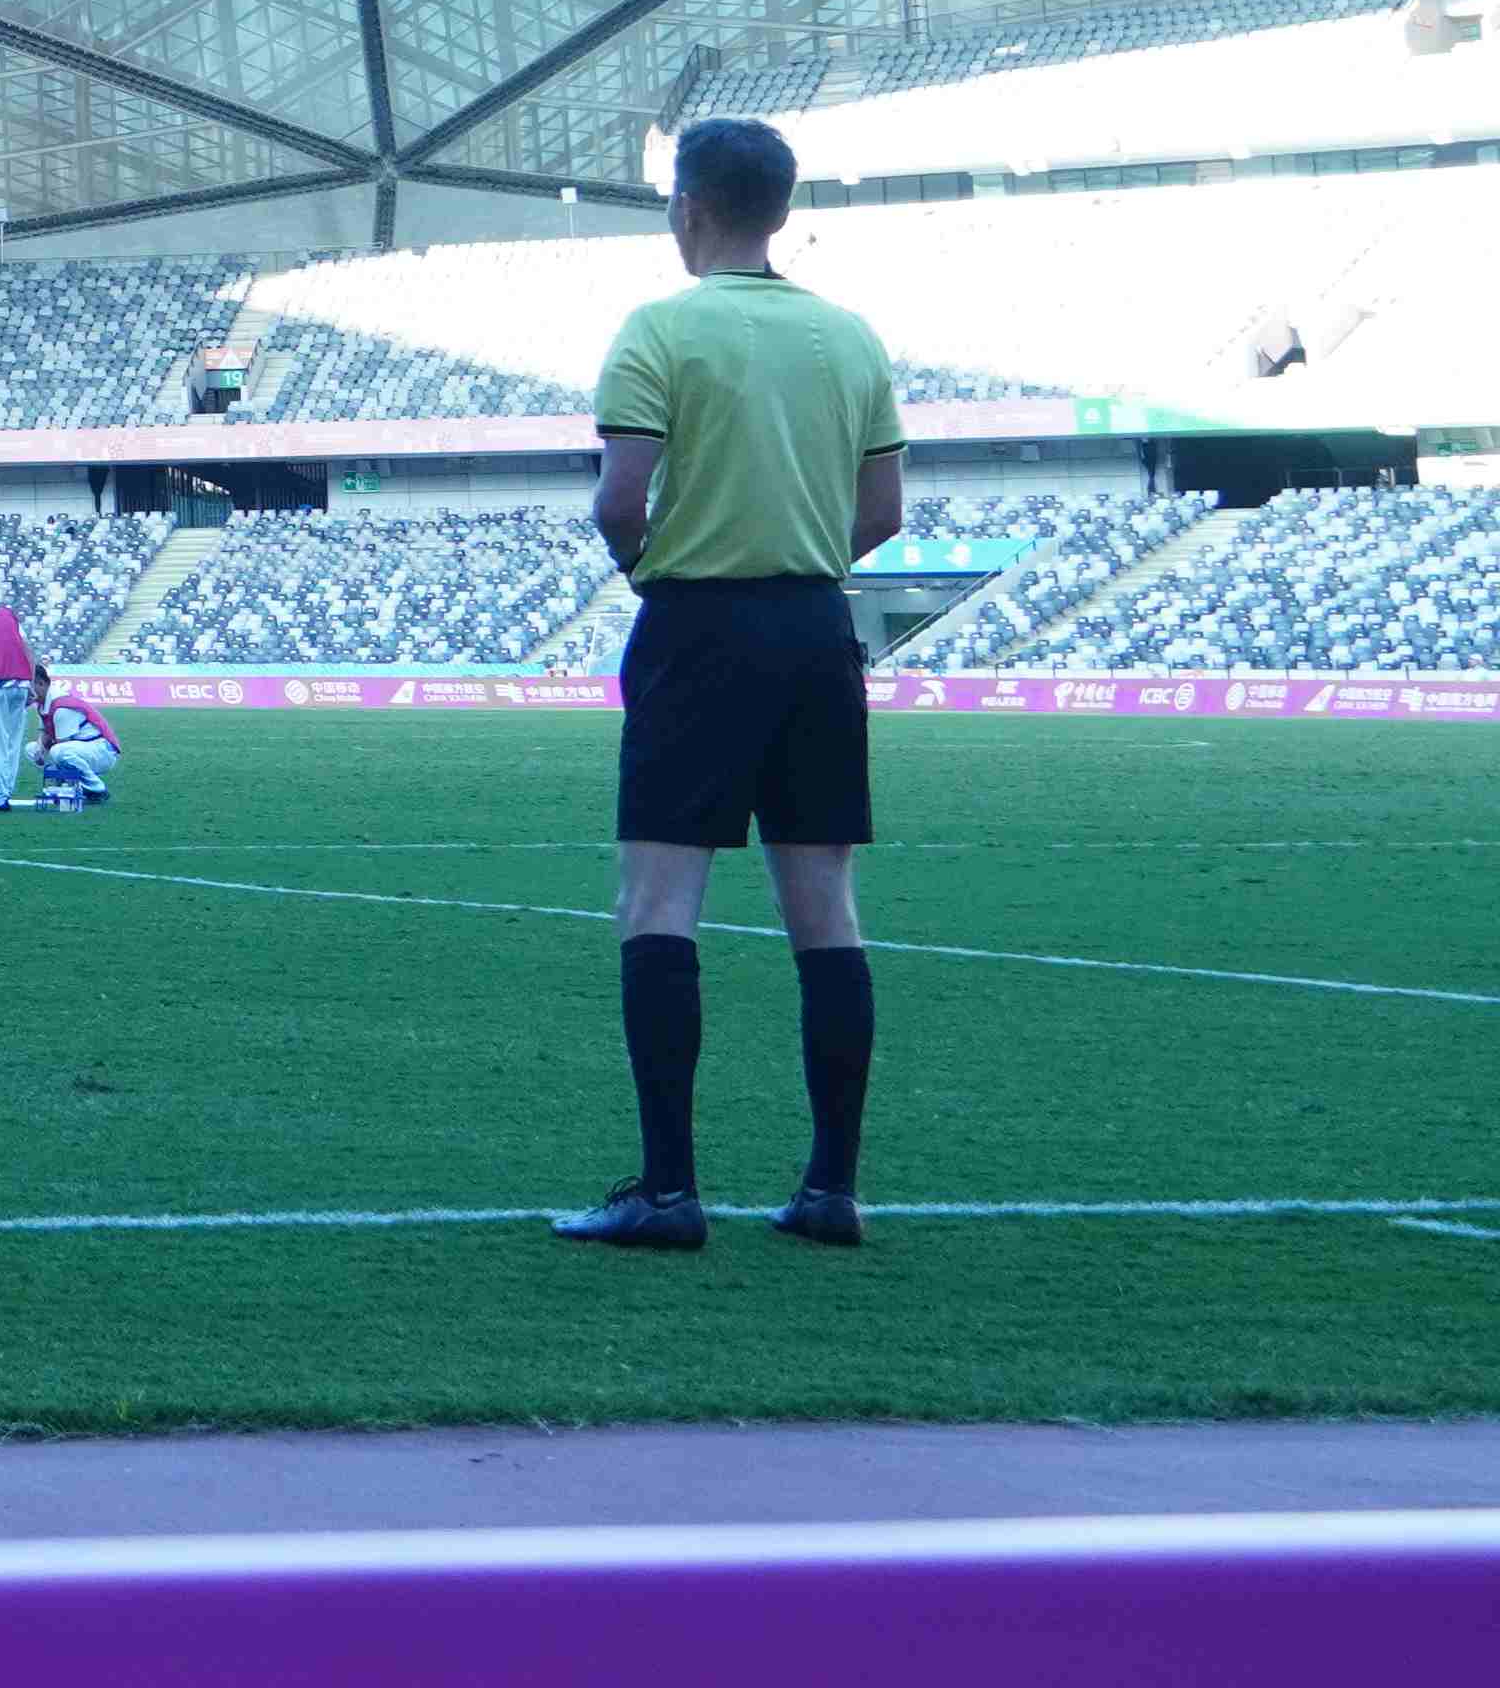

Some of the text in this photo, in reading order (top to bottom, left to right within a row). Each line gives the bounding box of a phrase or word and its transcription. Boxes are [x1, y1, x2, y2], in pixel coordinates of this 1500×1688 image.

[224, 372, 243, 388] 19
[169, 683, 215, 699] ICBC
[1139, 687, 1174, 705] ICBC
